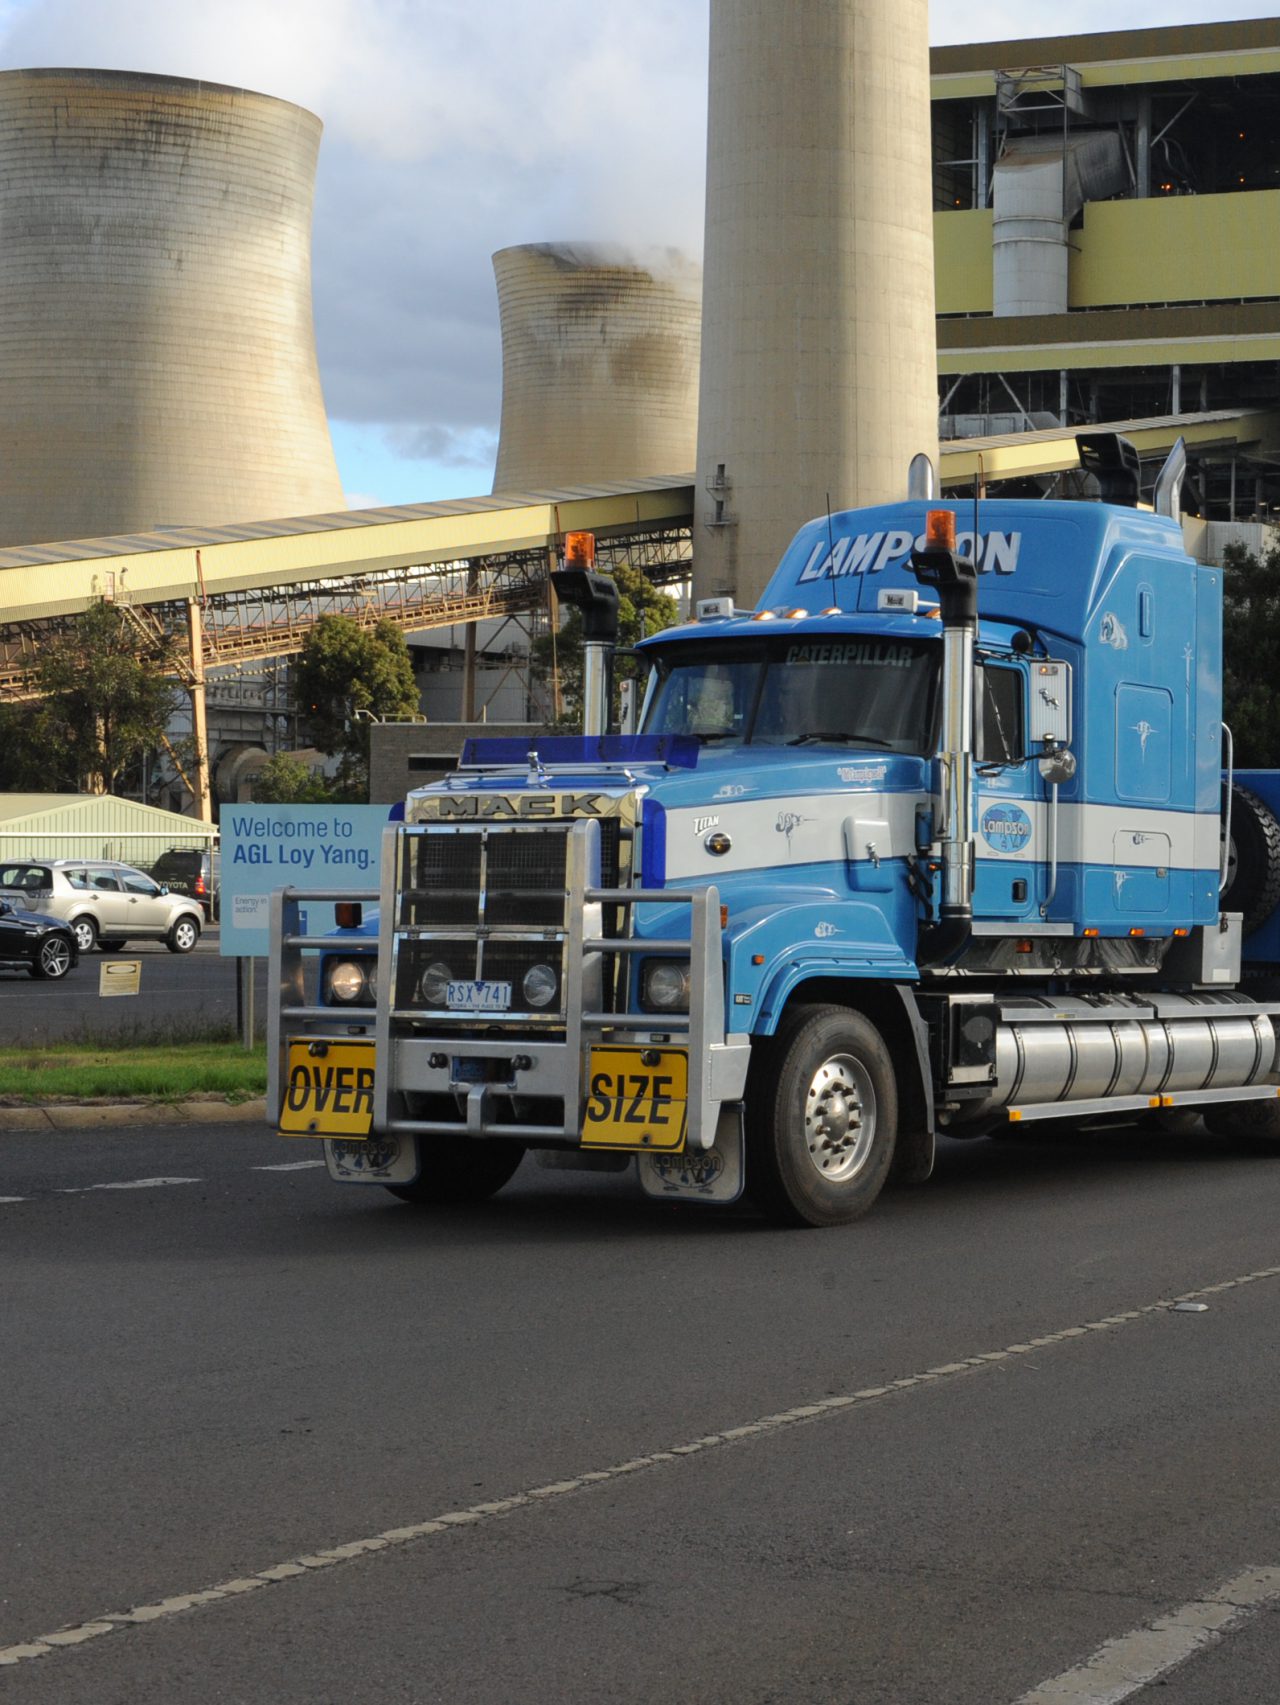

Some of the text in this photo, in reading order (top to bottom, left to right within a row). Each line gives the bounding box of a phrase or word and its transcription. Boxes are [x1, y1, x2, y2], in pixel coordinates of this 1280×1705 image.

[798, 530, 1022, 583] LAMPON
[786, 644, 913, 668] CATERPILLAR
[438, 794, 603, 816] MACK
[232, 817, 353, 838] Welcome to
[693, 815, 720, 833] TITAN
[233, 844, 376, 870] AGL Loy Yang.
[159, 881, 189, 890] TOYOTA
[235, 897, 260, 906] Energy
[448, 984, 509, 1004] RSX 741
[287, 1065, 375, 1114] OVER
[587, 1072, 673, 1125] SIZE
